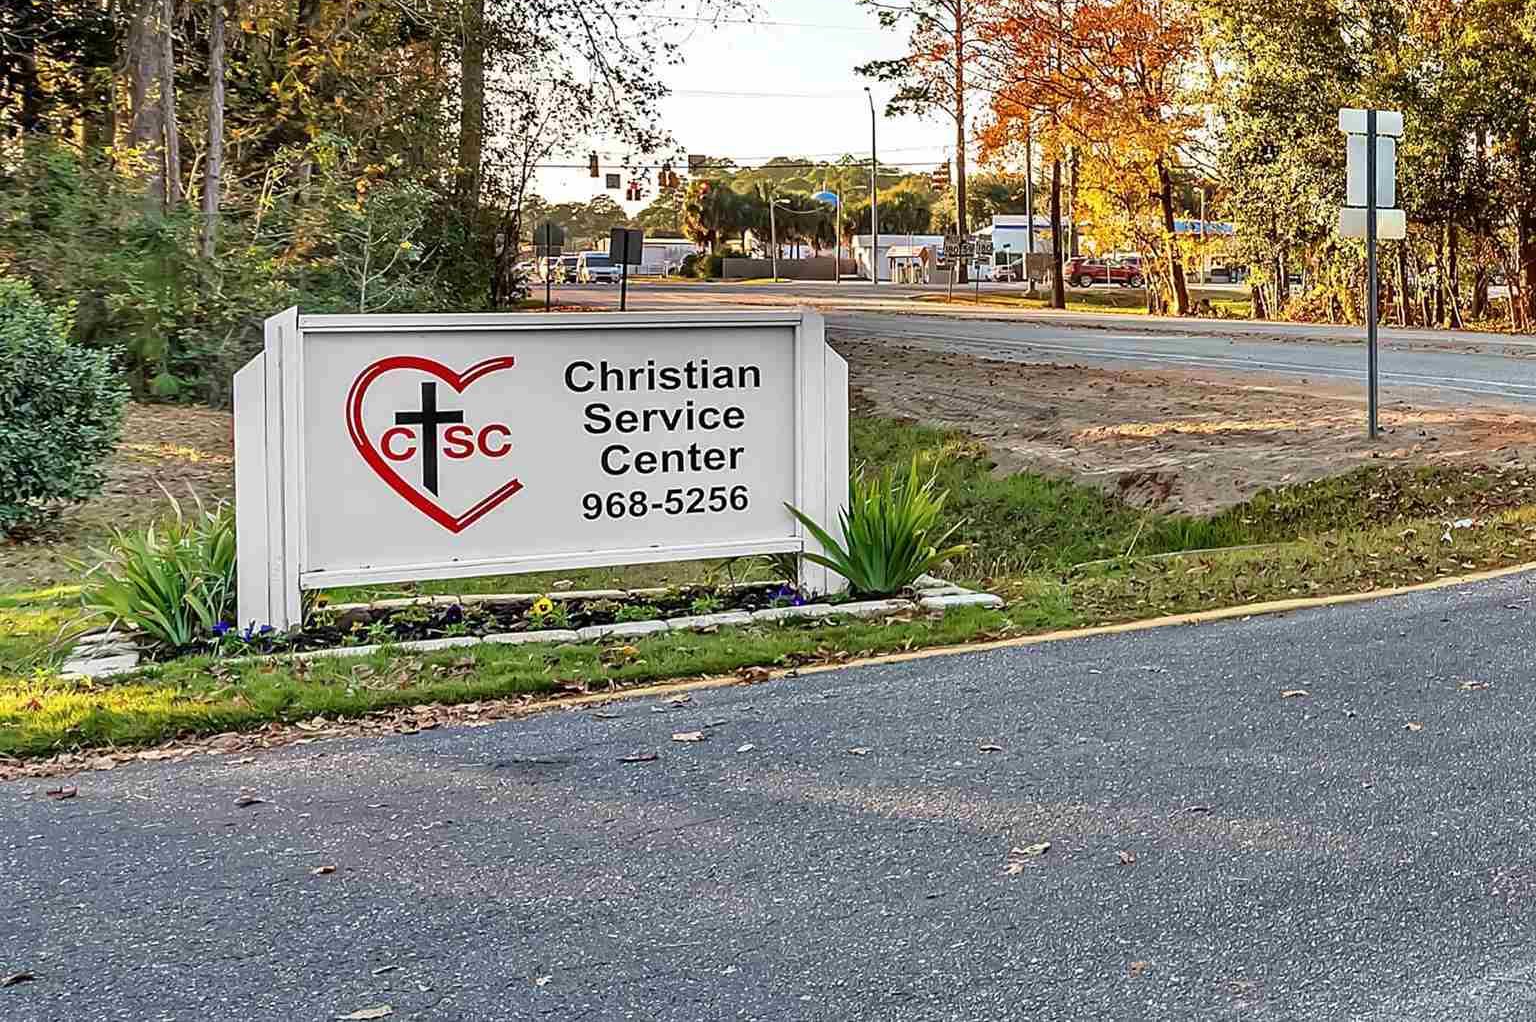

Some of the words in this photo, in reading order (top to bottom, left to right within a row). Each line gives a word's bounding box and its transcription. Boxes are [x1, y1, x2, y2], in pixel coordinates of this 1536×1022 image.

[564, 359, 761, 393] Christian
[583, 400, 745, 435] Service
[601, 442, 745, 476] Center
[582, 485, 748, 520] 968-5256
